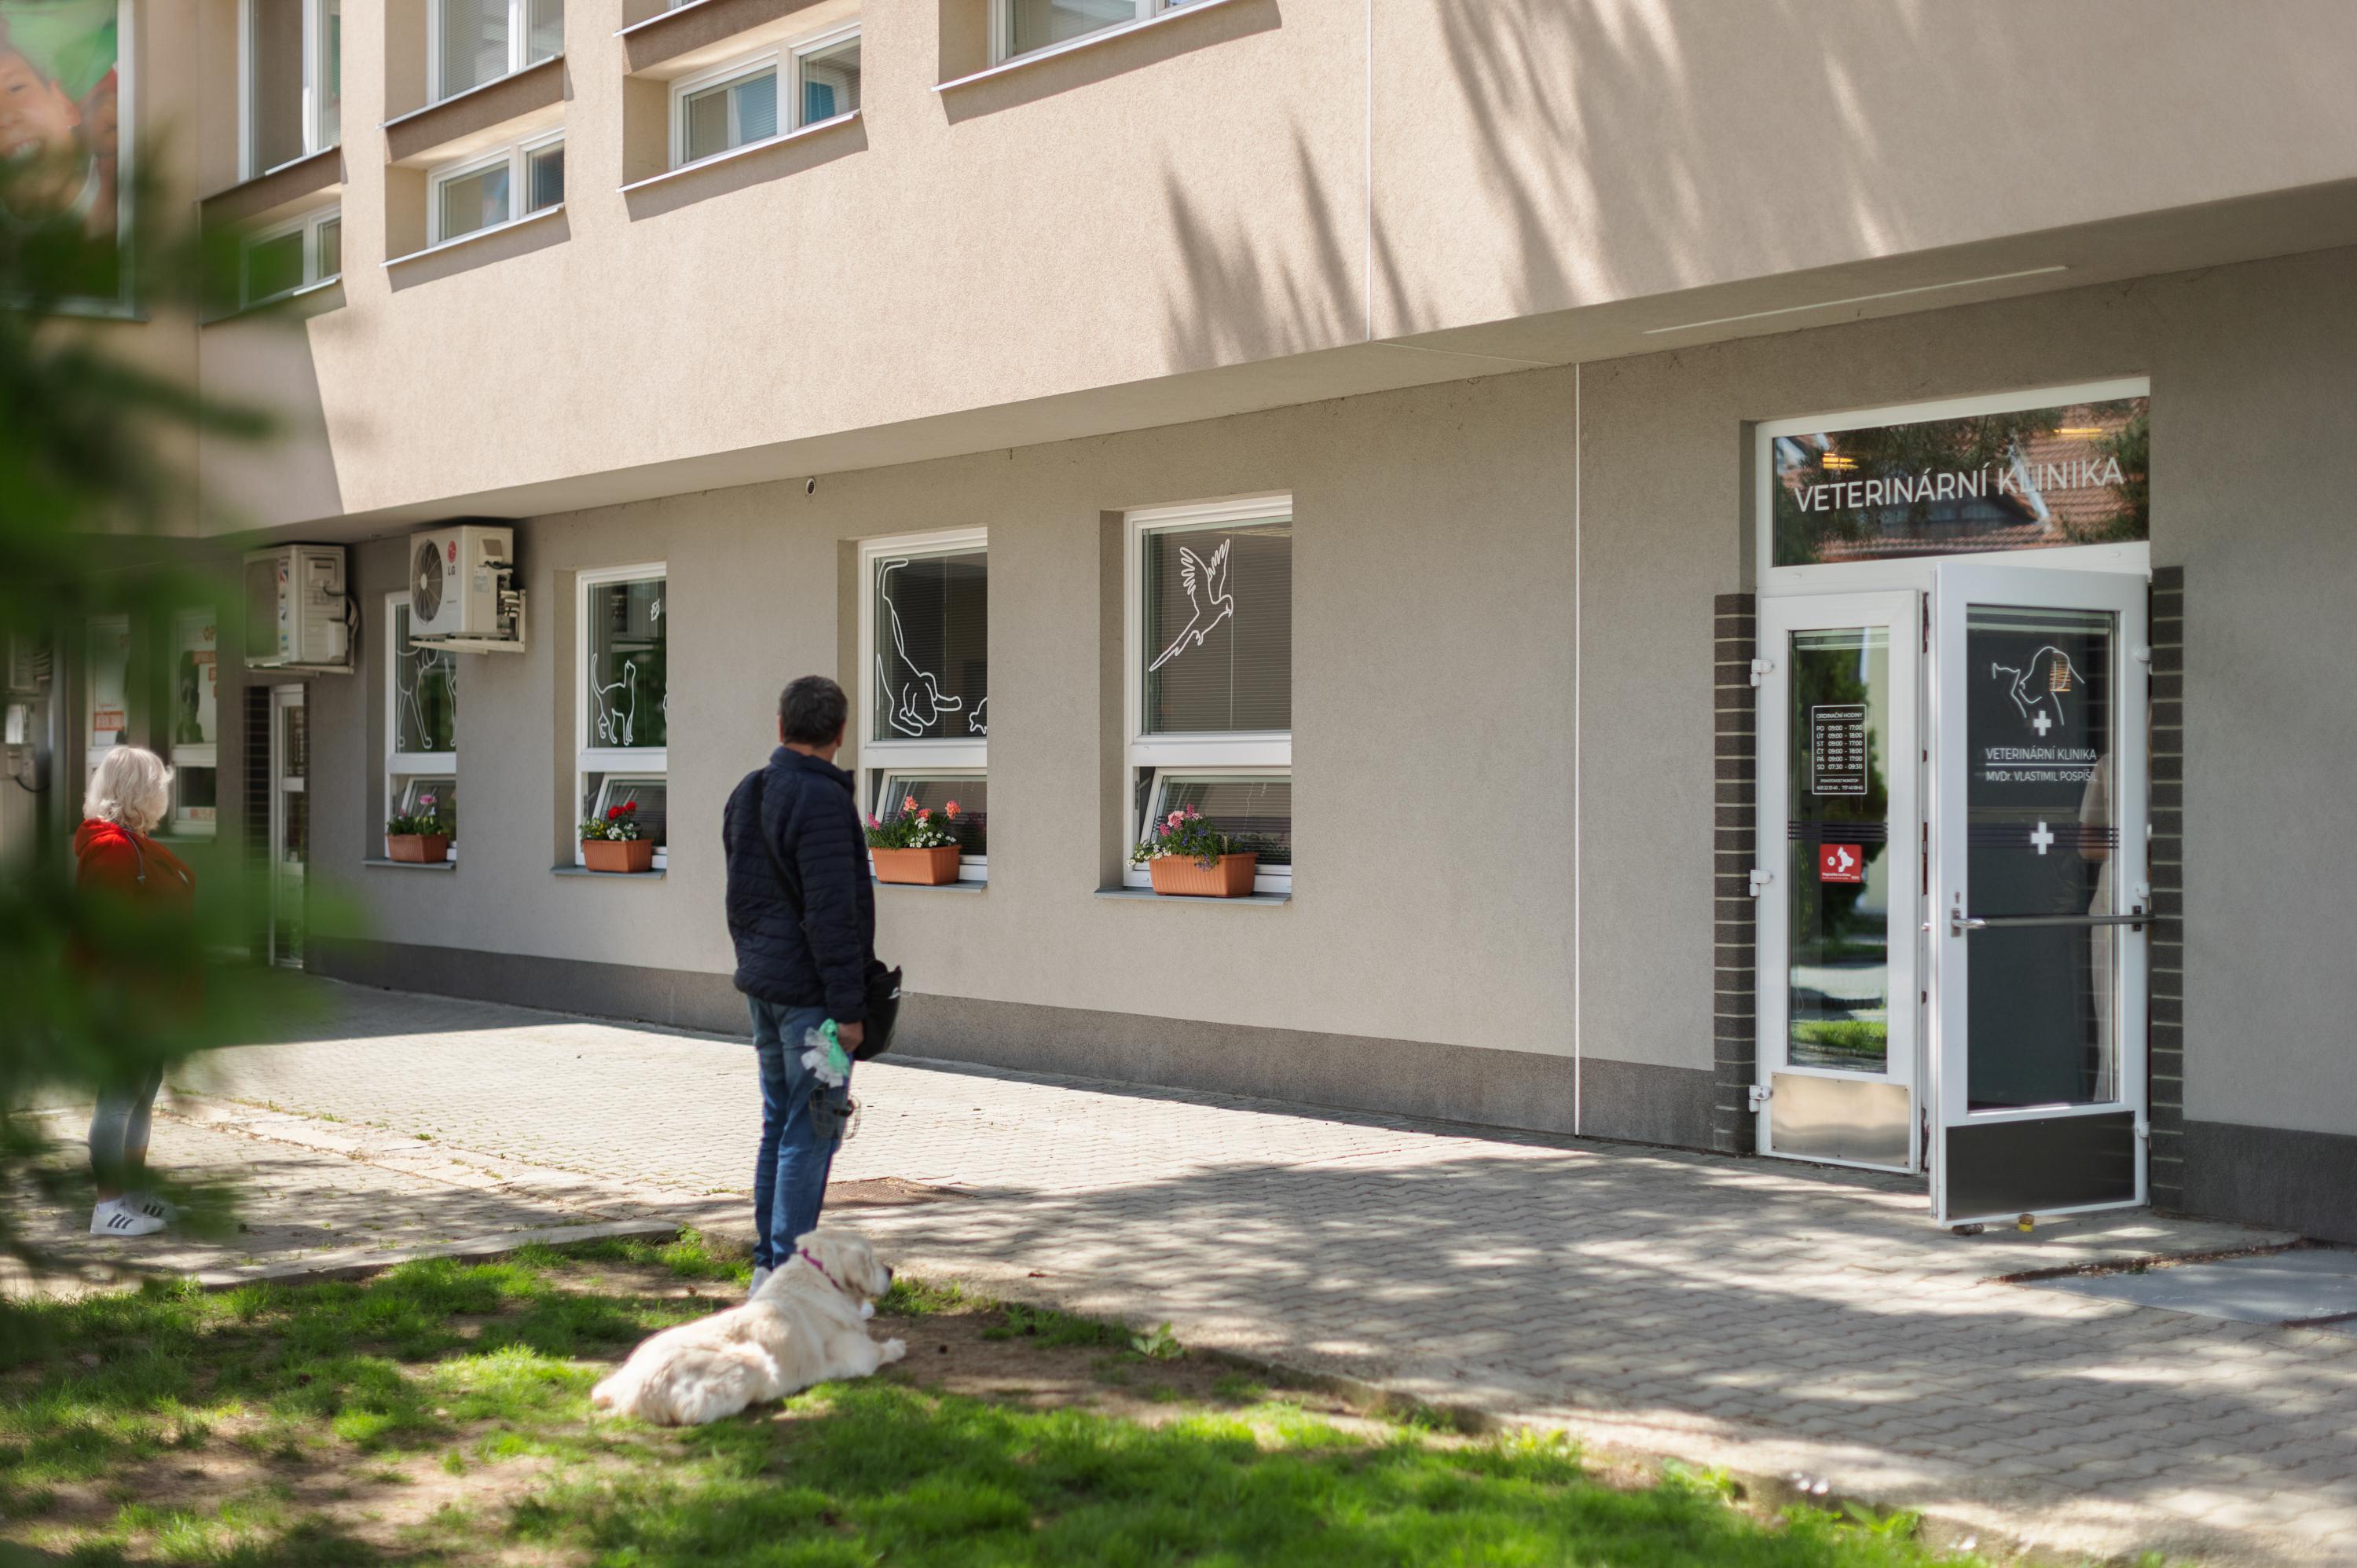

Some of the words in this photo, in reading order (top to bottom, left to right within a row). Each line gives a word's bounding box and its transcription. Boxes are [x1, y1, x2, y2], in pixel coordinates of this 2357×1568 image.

[1794, 462, 1989, 513] VETERINÁRNÍ
[1998, 456, 2124, 495] KLINIKA
[448, 566, 456, 576] LG
[1985, 745, 2055, 760] VETERINÁRNÍ
[2057, 748, 2097, 760] KLINIKA
[1986, 771, 2012, 781] MVDr.
[2014, 771, 2058, 781] VLASTIMIL
